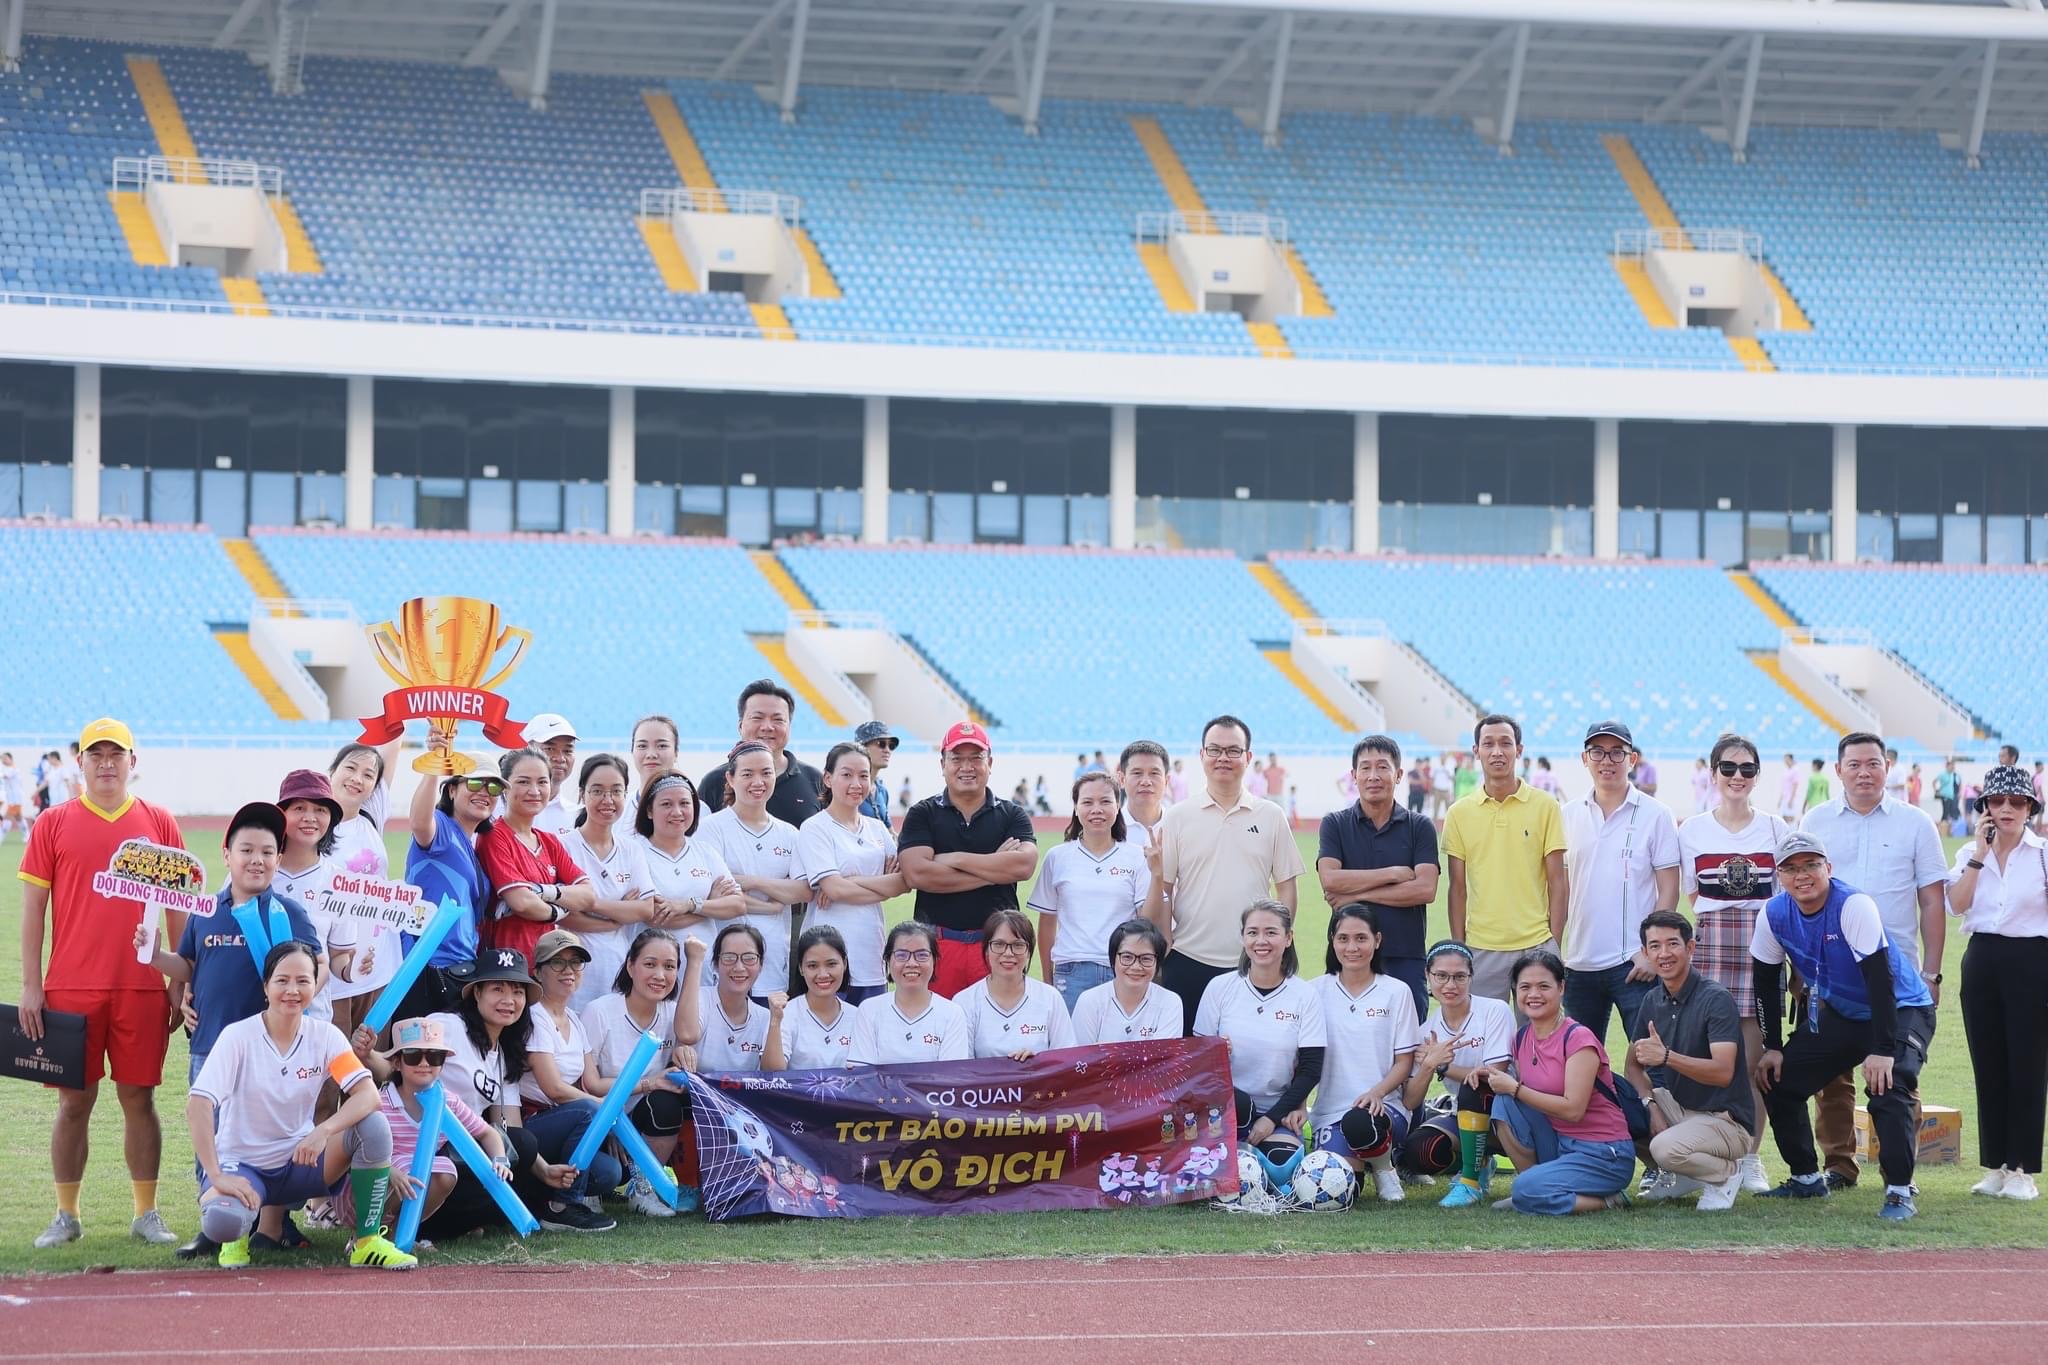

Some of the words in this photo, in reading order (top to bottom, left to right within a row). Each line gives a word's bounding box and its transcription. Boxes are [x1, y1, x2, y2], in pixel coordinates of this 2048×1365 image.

[435, 619, 462, 656] 1
[407, 692, 485, 716] WINNER
[154, 887, 193, 909] TRONG
[320, 890, 347, 918] Tay
[382, 905, 406, 928] cúp
[363, 880, 393, 903] bóng
[395, 885, 417, 906] hay
[745, 1081, 793, 1090] INSURANCE
[926, 1088, 957, 1107] CƠ
[962, 1087, 1022, 1108] QUAN
[836, 1121, 894, 1143] TCT
[900, 1111, 966, 1142] BẢO
[973, 1110, 1046, 1138] HIỂM
[1055, 1112, 1102, 1134] PVI
[1474, 1133, 1487, 1172] WINTERS
[879, 1149, 943, 1192] VÔ
[955, 1150, 1064, 1195] ĐỊCH
[364, 1176, 388, 1228] WINTERS
